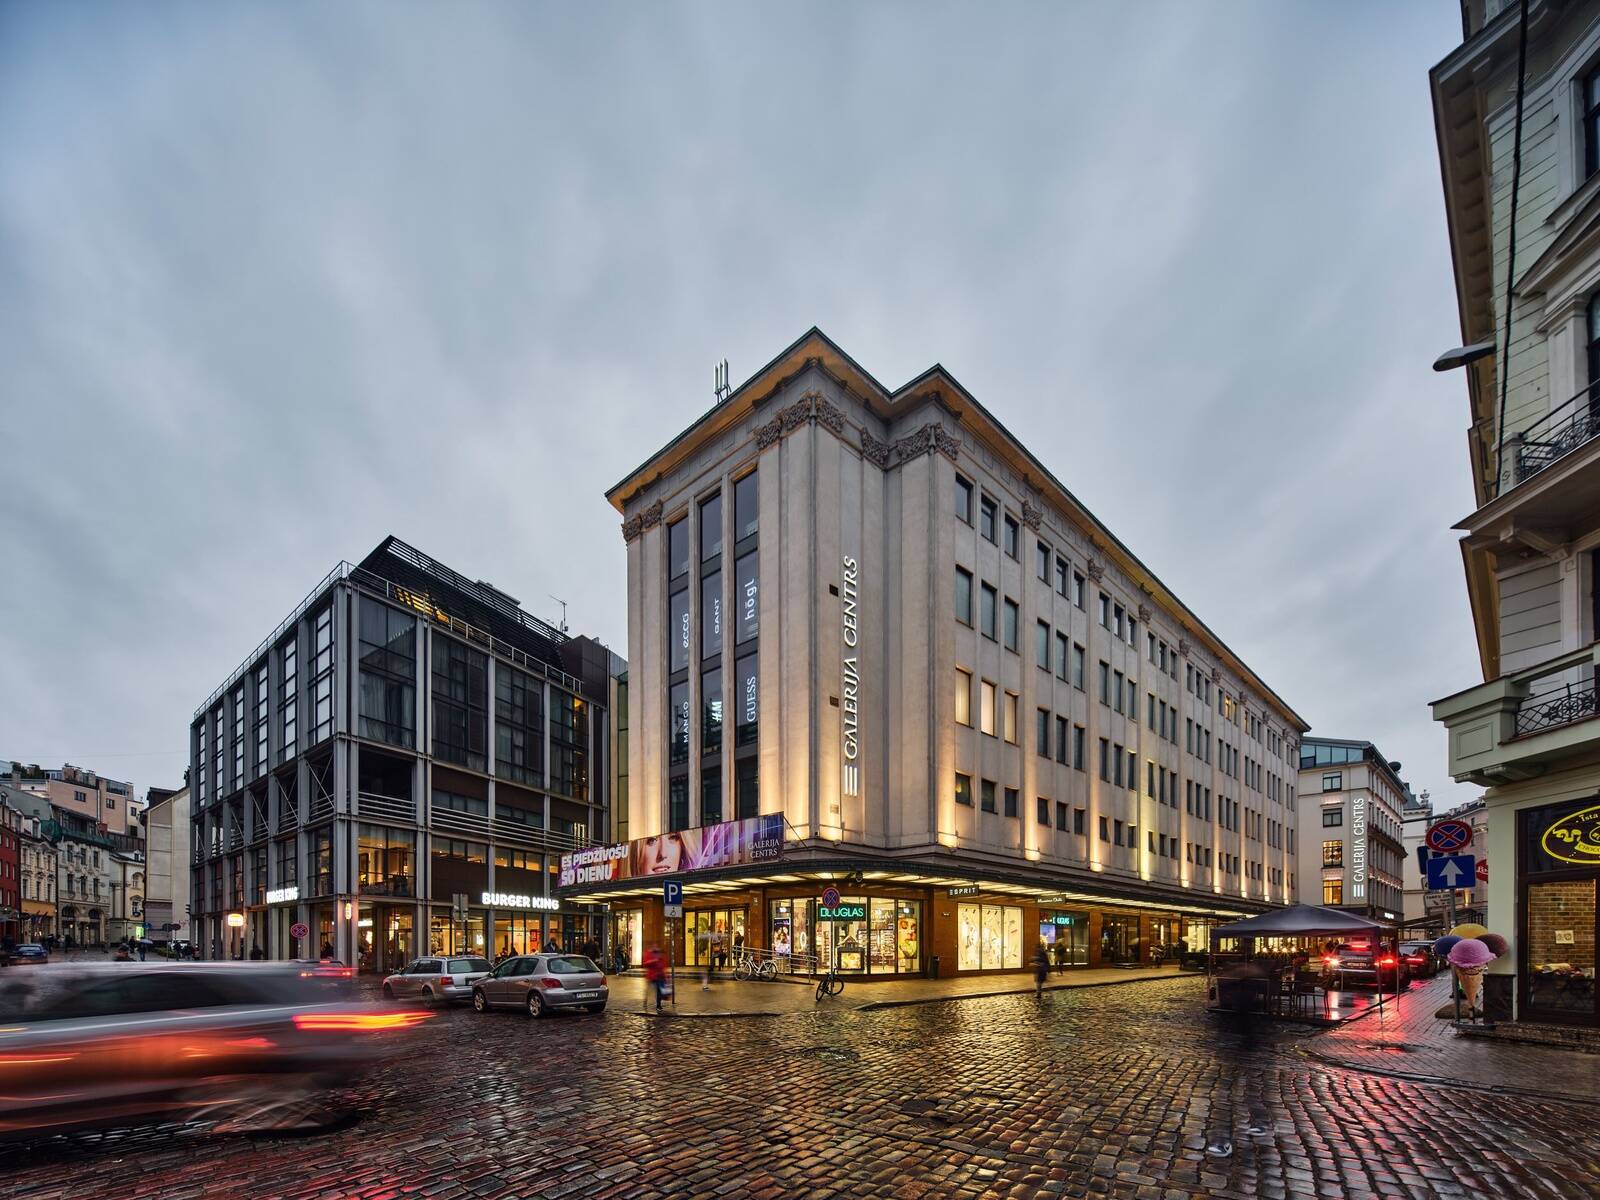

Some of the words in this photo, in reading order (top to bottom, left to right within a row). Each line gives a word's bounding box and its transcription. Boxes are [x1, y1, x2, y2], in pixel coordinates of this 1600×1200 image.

[844, 555, 858, 647] CENTRS
[746, 676, 756, 722] GUESS
[844, 656, 859, 760] GALERIJA
[1353, 798, 1364, 836] CENTRS
[748, 839, 780, 850] GALERIJA
[751, 848, 778, 859] CENTRS
[576, 864, 613, 884] DIENU
[1353, 838, 1366, 882] GALERIJA
[481, 892, 531, 908] BURGER
[532, 896, 560, 910] KING
[668, 883, 678, 902] P
